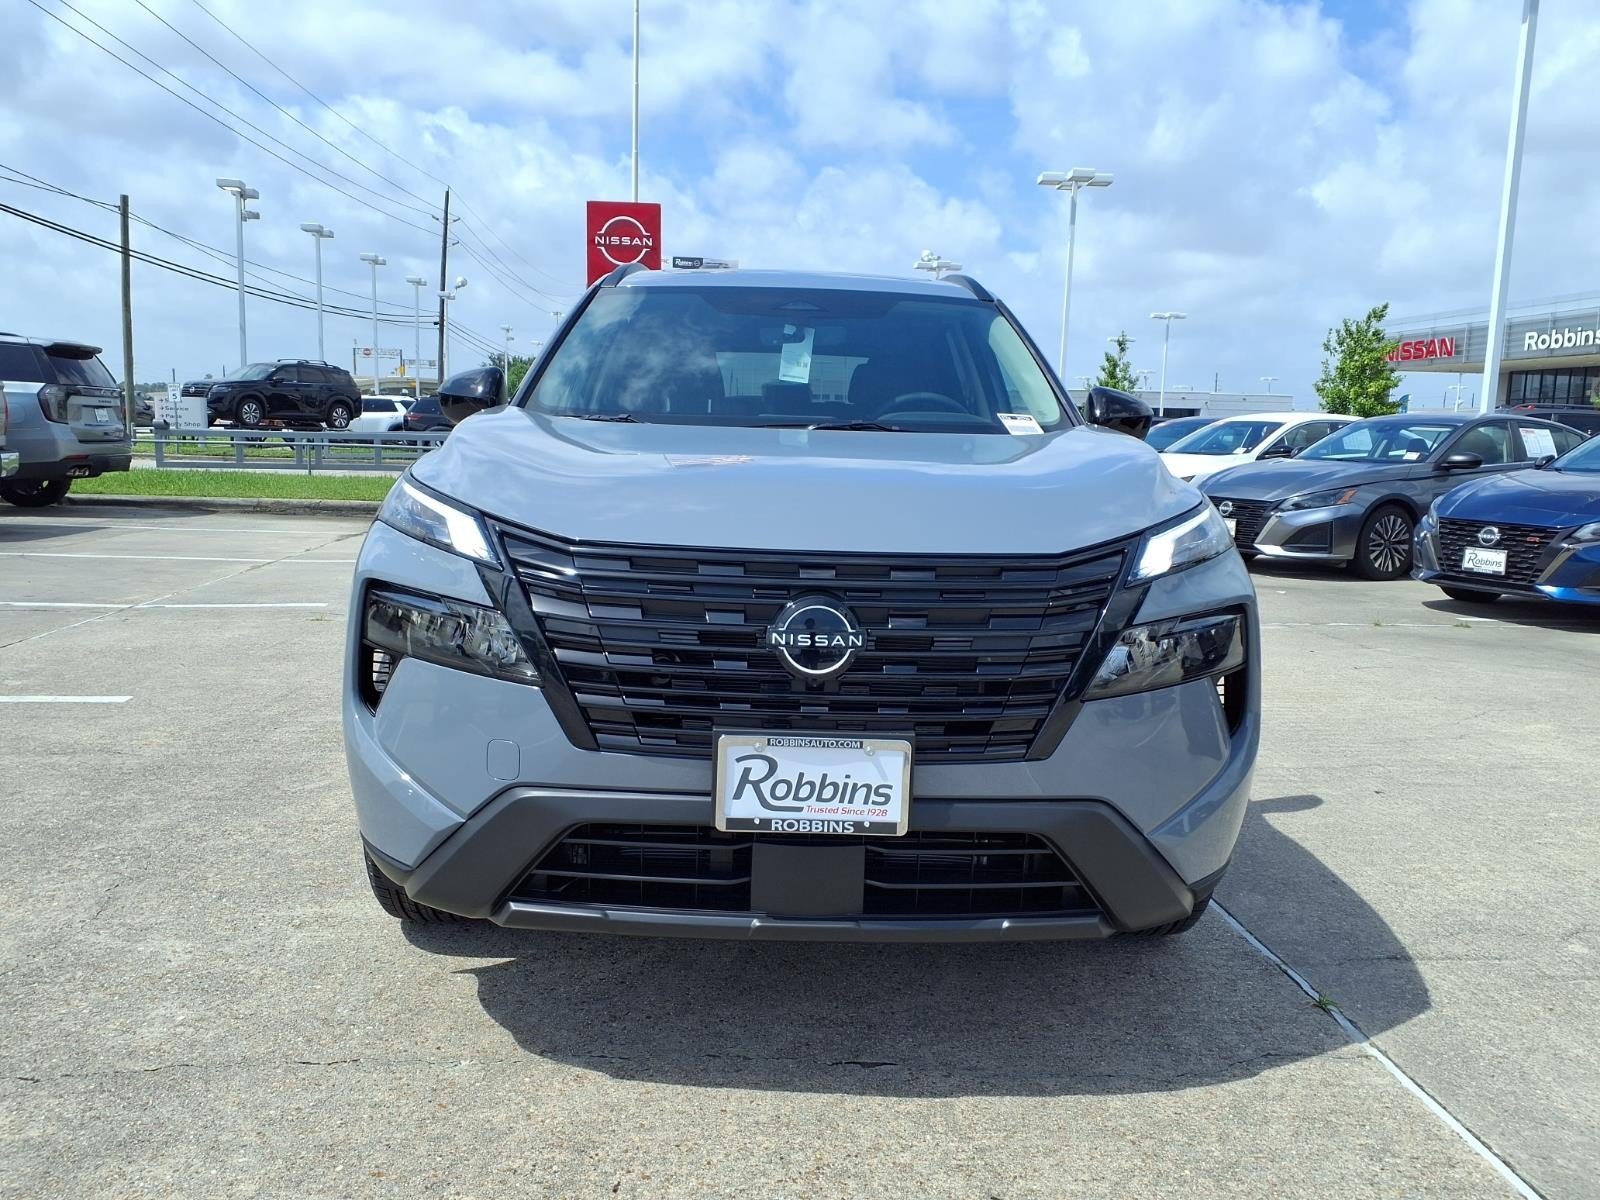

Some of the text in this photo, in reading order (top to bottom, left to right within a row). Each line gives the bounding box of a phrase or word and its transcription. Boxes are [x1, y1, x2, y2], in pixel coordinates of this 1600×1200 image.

[594, 236, 653, 247] NISSAN
[1467, 552, 1503, 568] Robbins
[771, 632, 862, 647] NISSAN
[769, 738, 861, 749] ROBBINSAUTO.COM
[732, 753, 894, 813] Robbins
[806, 805, 888, 817] Trusted Since 1928
[771, 819, 855, 833] ROBBINS
